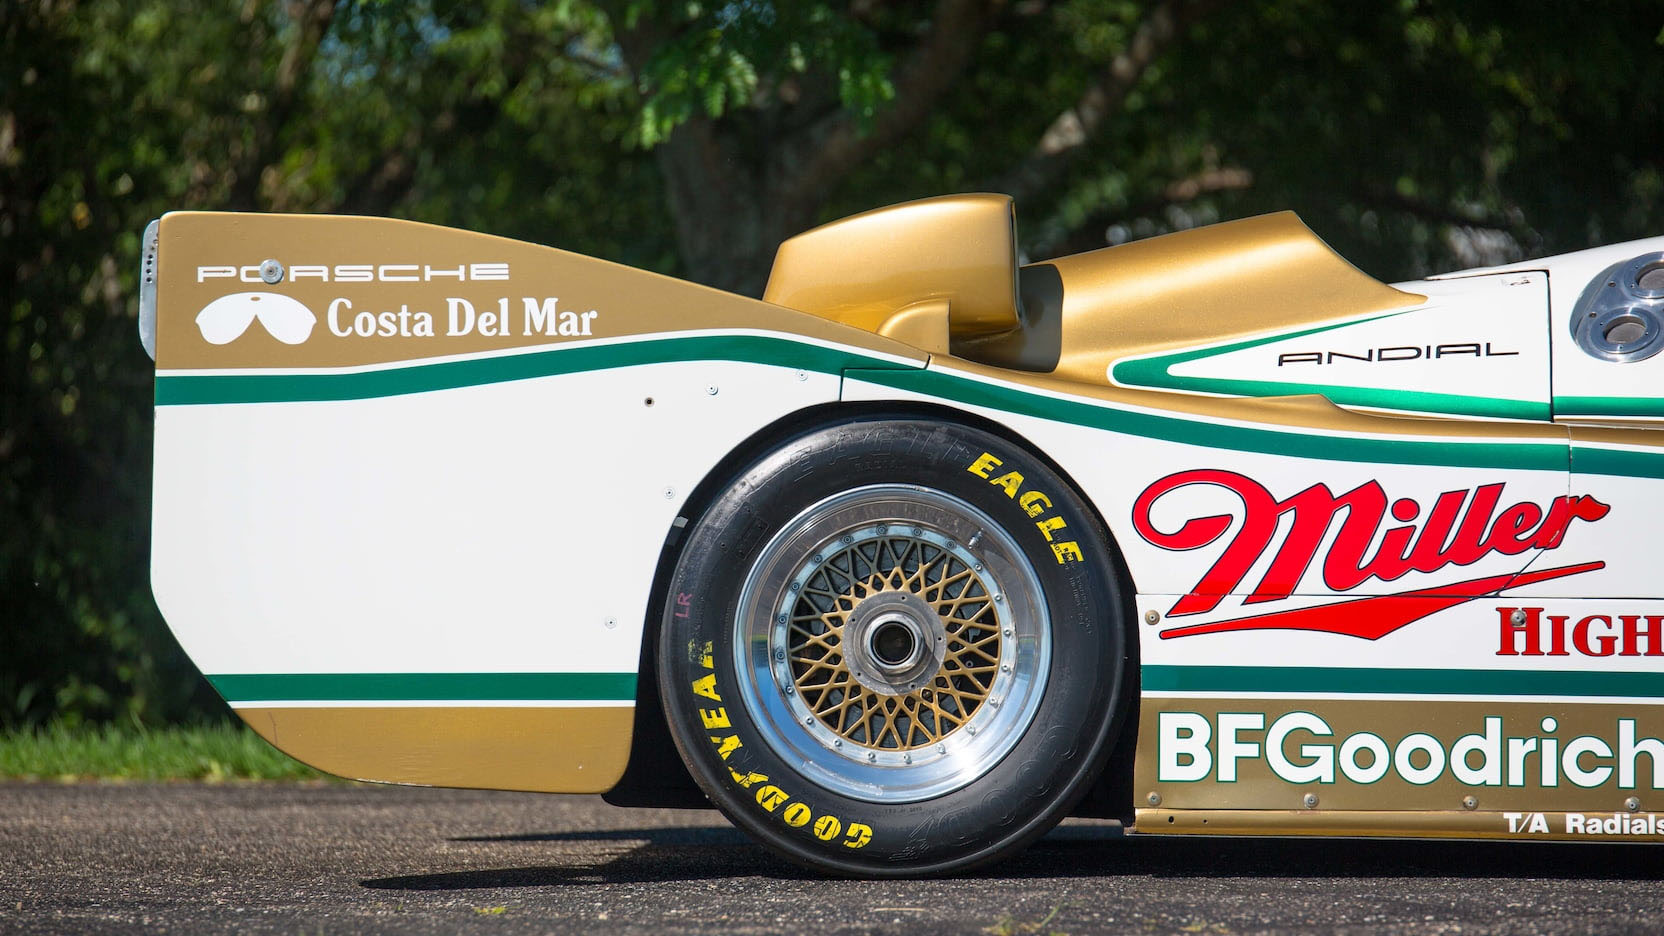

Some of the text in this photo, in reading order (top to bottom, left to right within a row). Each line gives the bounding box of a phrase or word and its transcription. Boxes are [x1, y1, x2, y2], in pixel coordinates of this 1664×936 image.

[327, 297, 599, 338] Costa Del Mar
[1278, 342, 1520, 367] ANDIAL
[966, 451, 1085, 565] EAGLE
[1132, 468, 1612, 619] Miller
[1495, 606, 1664, 657] HIGH
[1157, 711, 1664, 790] BFGoodrich
[1503, 812, 1550, 834] T/A
